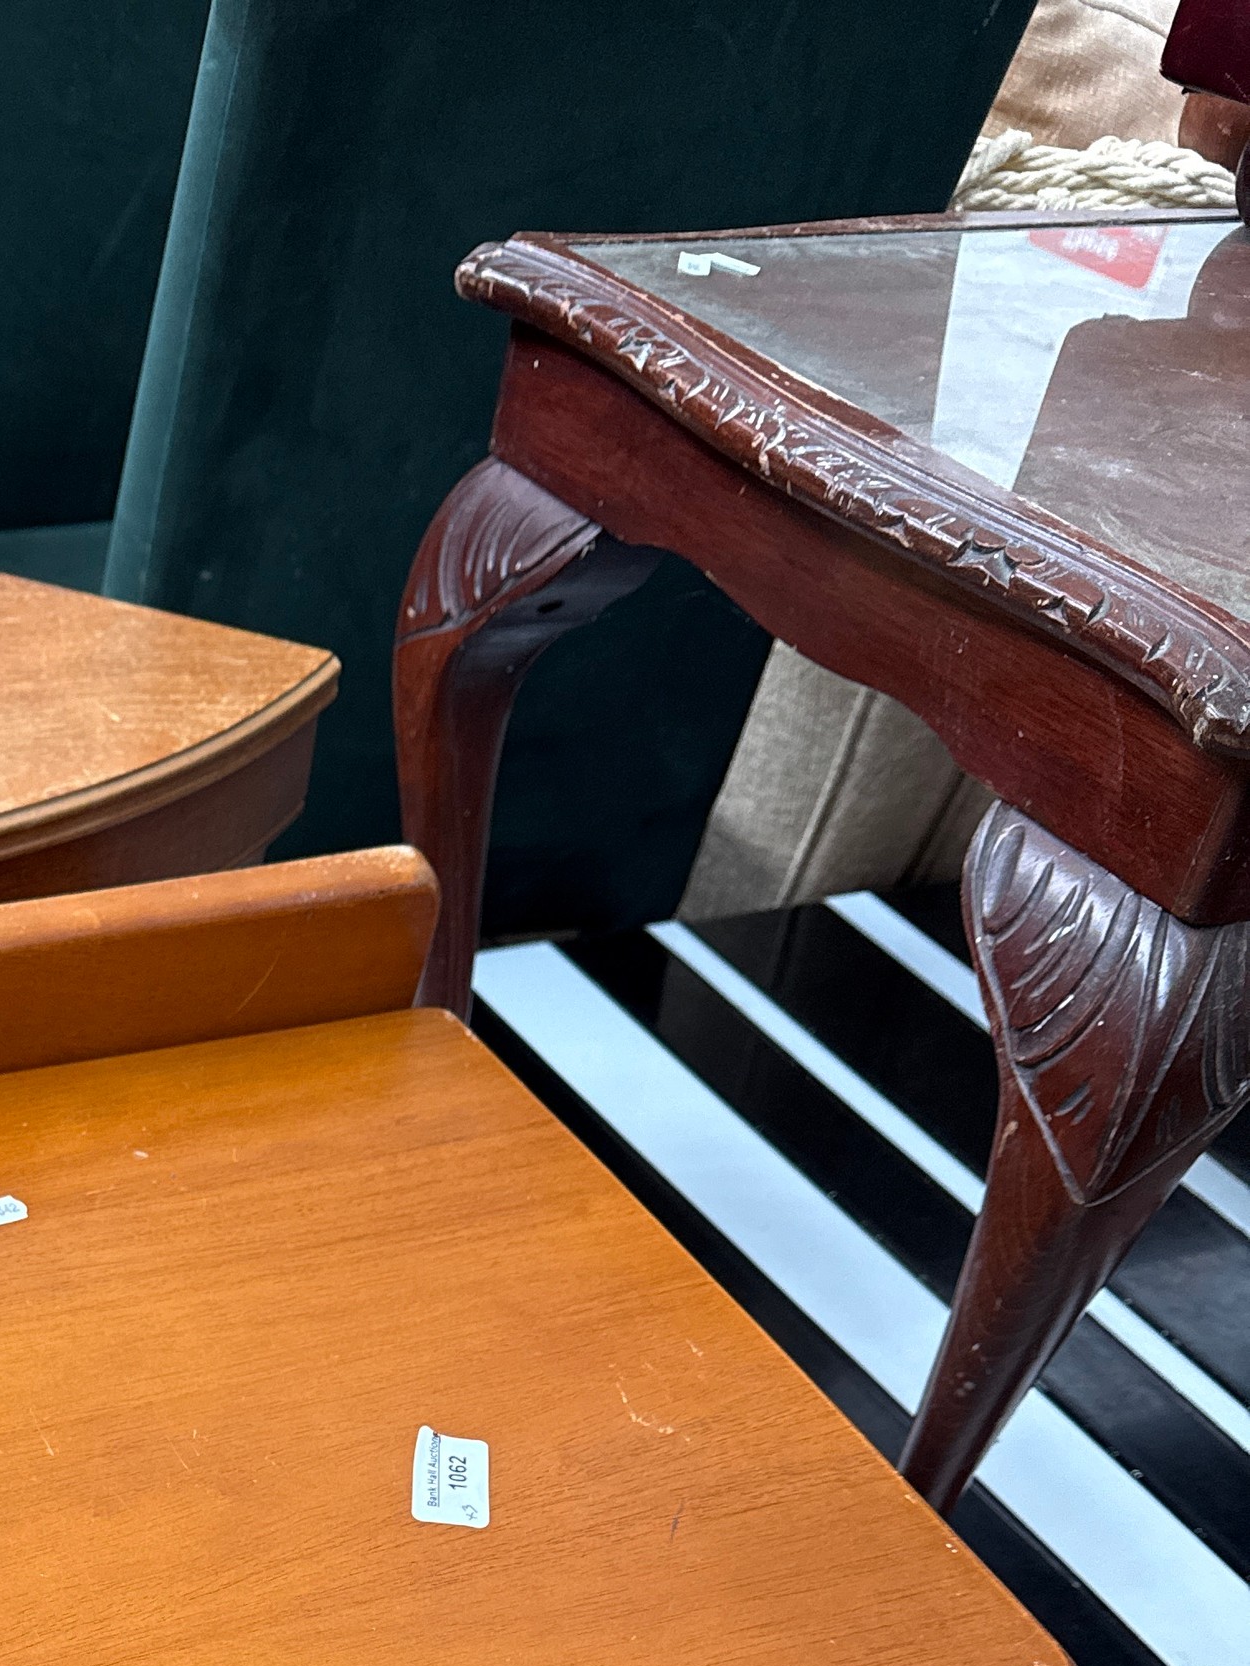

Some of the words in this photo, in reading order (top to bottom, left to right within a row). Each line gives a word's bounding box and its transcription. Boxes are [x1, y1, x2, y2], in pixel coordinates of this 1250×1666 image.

[427, 1432, 438, 1469] Auction
[427, 1470, 437, 1485] Hall
[448, 1455, 467, 1491] 1062
[427, 1488, 437, 1507] Bank
